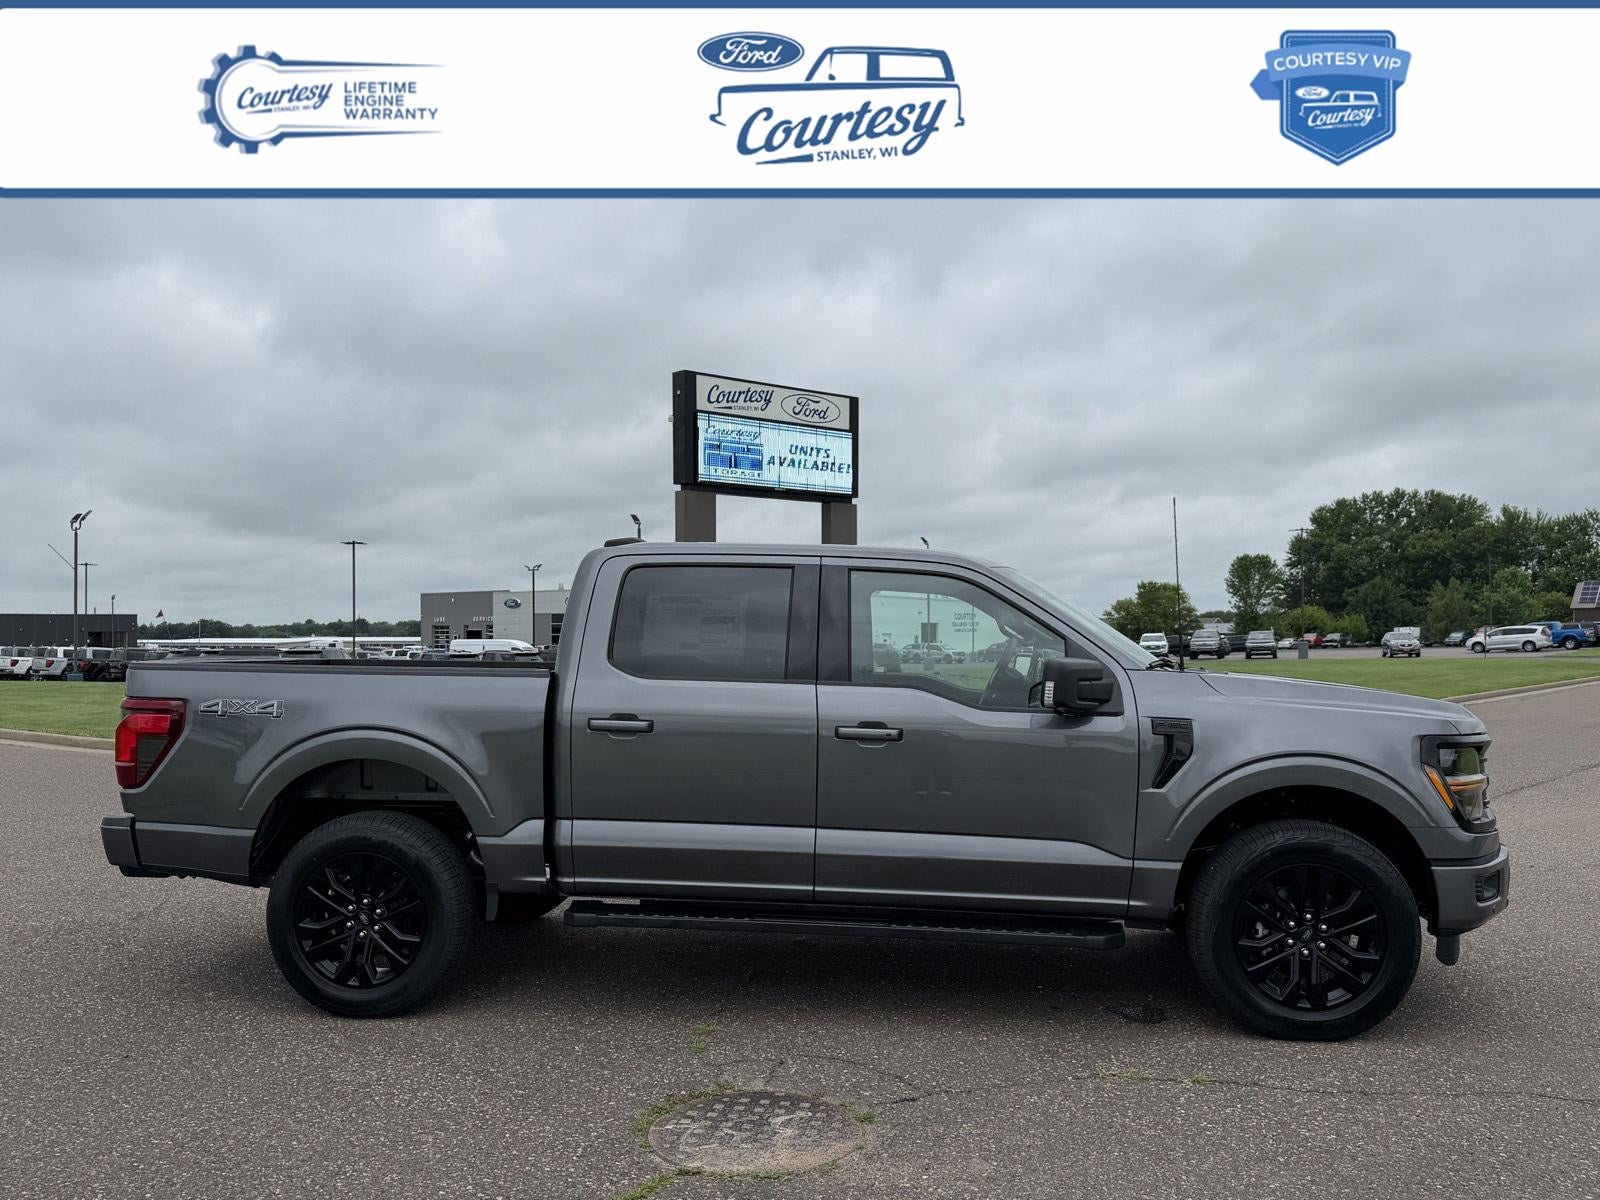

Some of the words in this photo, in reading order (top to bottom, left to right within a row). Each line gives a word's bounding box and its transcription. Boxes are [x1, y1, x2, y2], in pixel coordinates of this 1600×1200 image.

[707, 384, 774, 411] Courtesy
[792, 396, 830, 420] Ford
[788, 444, 831, 459] UNITS
[766, 455, 851, 474] AVAILABLE!
